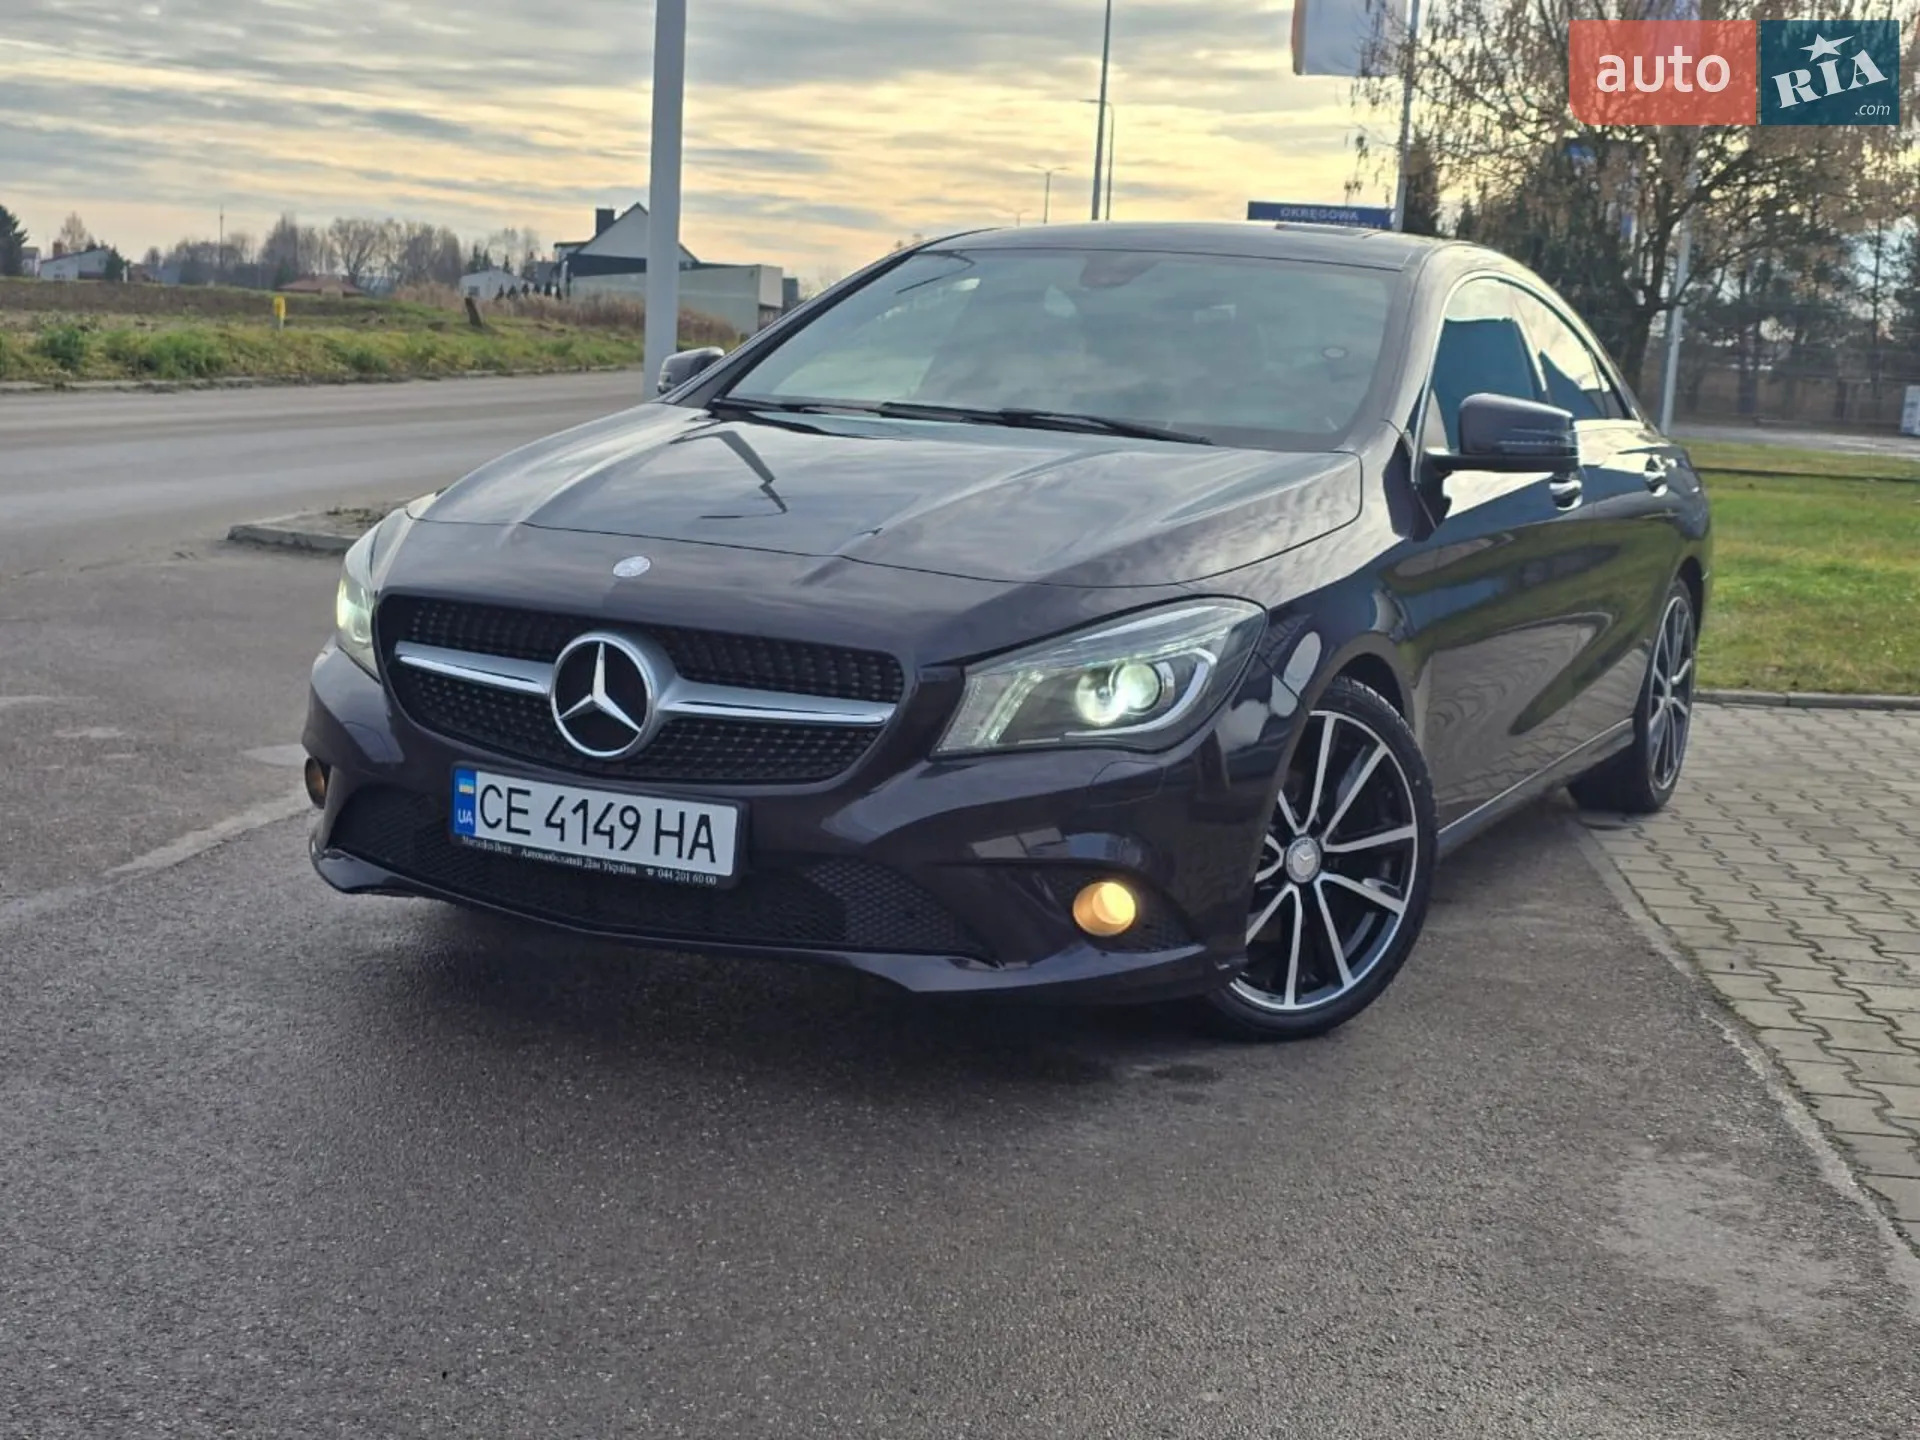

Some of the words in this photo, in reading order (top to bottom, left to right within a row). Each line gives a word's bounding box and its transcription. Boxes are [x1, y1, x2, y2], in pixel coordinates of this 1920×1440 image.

[457, 809, 473, 826] UA
[479, 784, 532, 837] CE
[544, 795, 642, 851] 4149
[654, 807, 717, 864] HA
